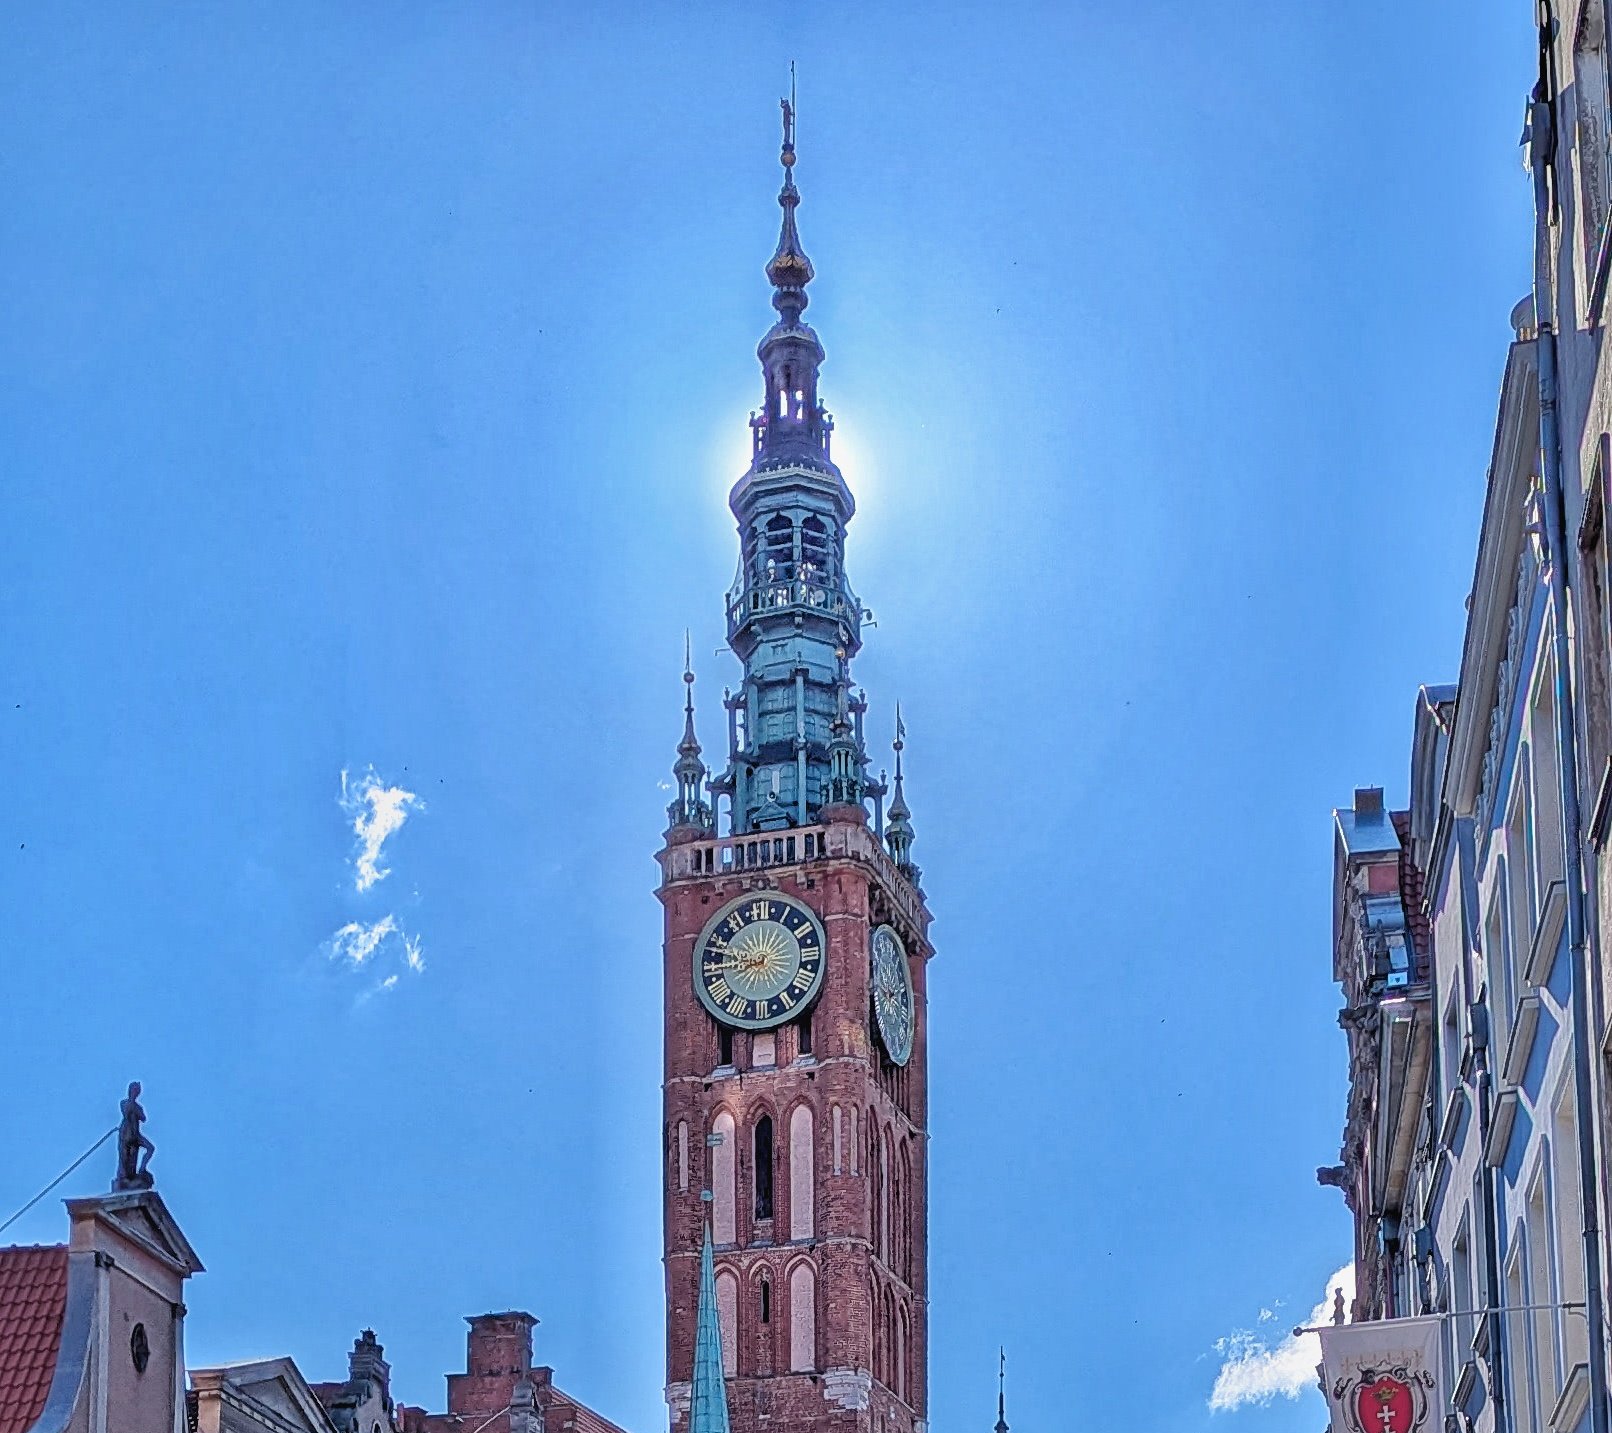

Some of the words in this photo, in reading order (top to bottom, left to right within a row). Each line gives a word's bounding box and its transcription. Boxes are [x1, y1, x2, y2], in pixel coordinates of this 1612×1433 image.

[750, 900, 769, 921] XII
[793, 921, 813, 939] II
[801, 946, 819, 962] III
